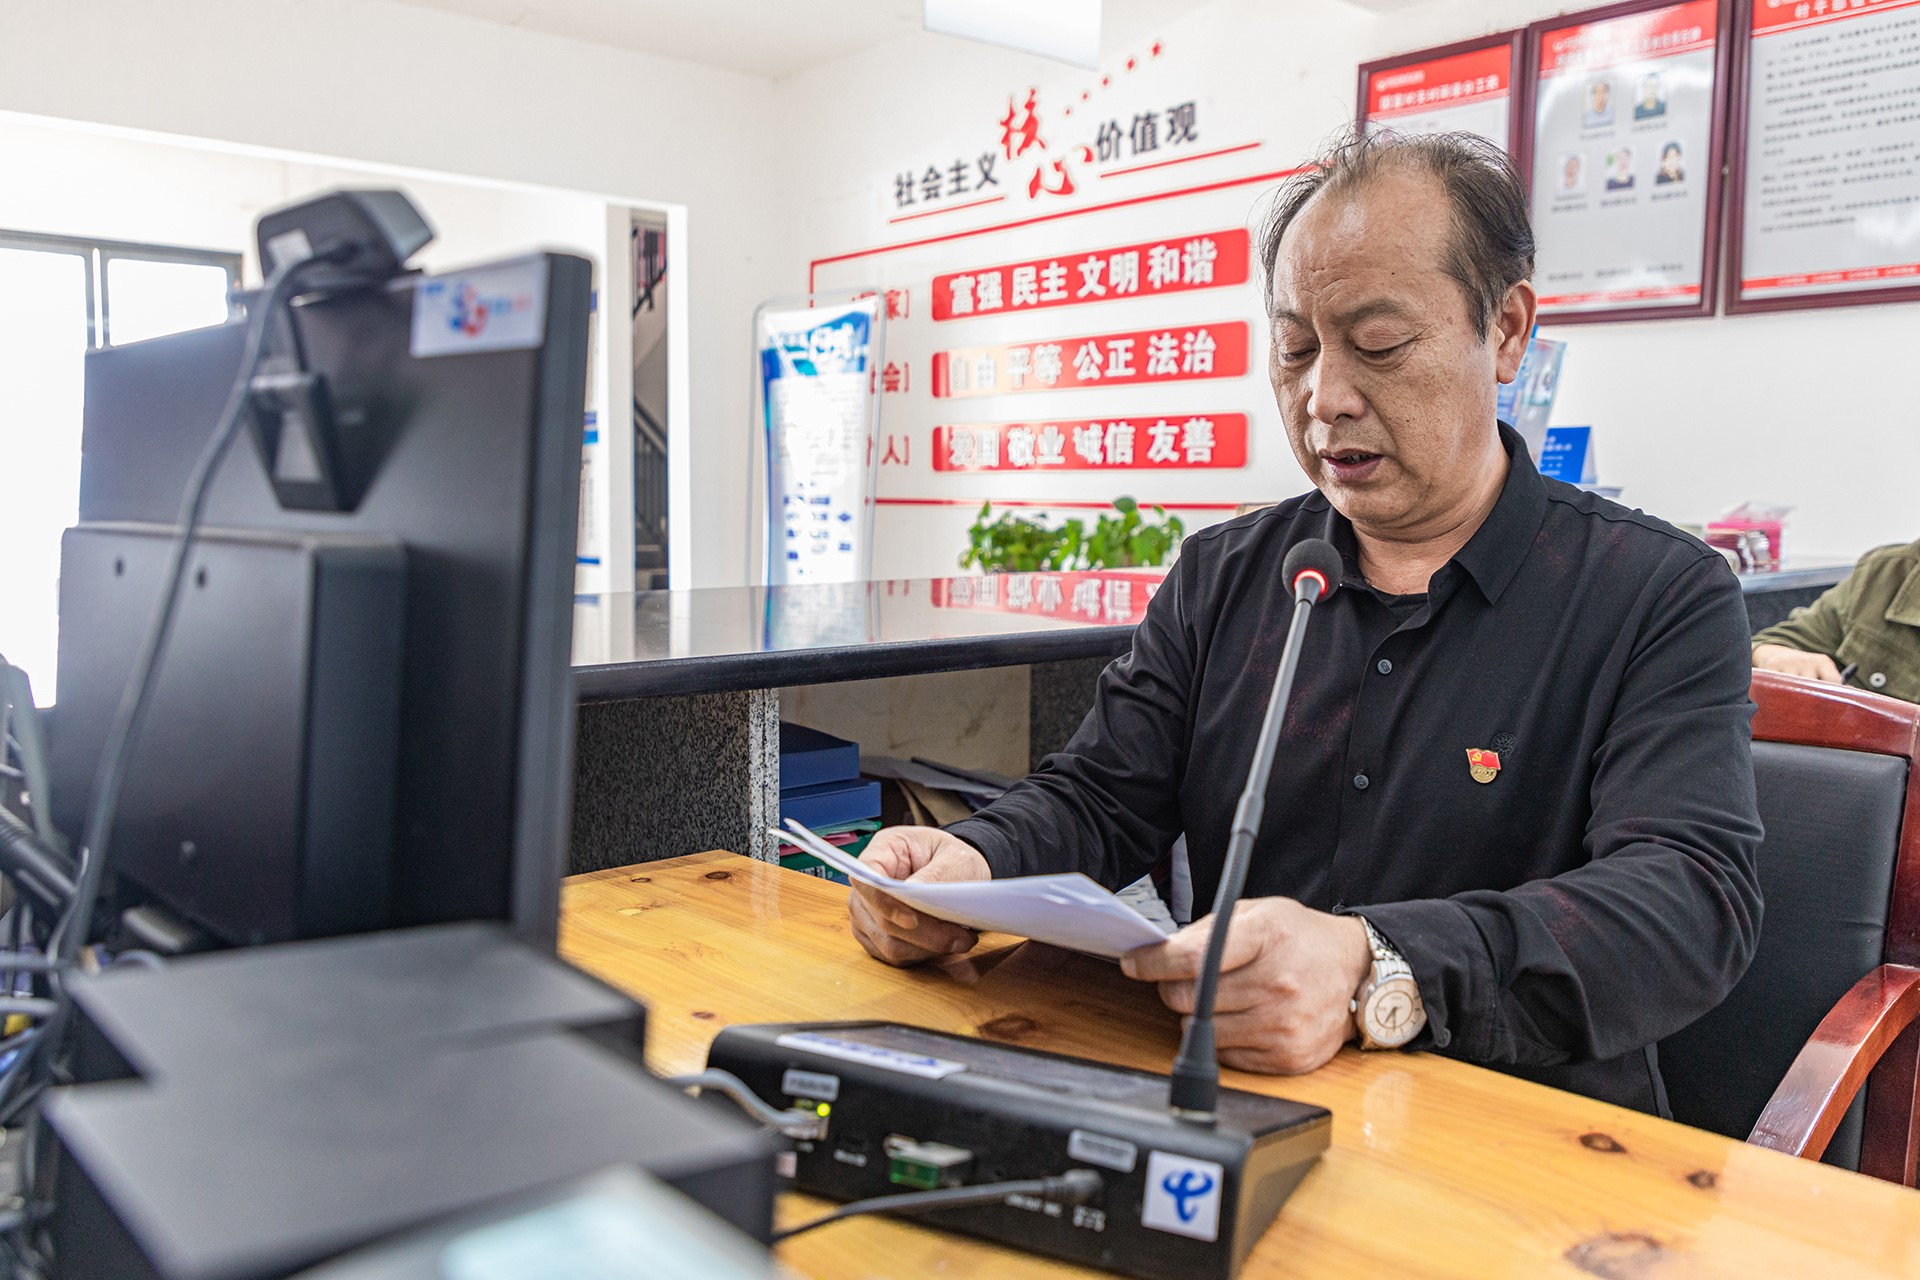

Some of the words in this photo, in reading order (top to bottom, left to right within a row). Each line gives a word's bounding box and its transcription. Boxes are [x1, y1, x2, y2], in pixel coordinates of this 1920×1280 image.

[894, 152, 999, 208] 社会主义
[1000, 87, 1094, 200] 核心
[1096, 101, 1198, 162] 价值观
[950, 269, 1003, 315] 富强
[1011, 261, 1068, 306] 民主
[1076, 250, 1140, 299] 文明
[1147, 237, 1217, 289] 和谐
[950, 353, 998, 391] 自由
[1007, 343, 1063, 388] 平等
[1073, 338, 1137, 381] 公正
[1147, 328, 1217, 375] 法治
[949, 428, 1000, 467] 爱国
[1007, 424, 1066, 467] 敬业
[1073, 420, 1136, 465] 诚信
[1147, 415, 1217, 465] 友善
